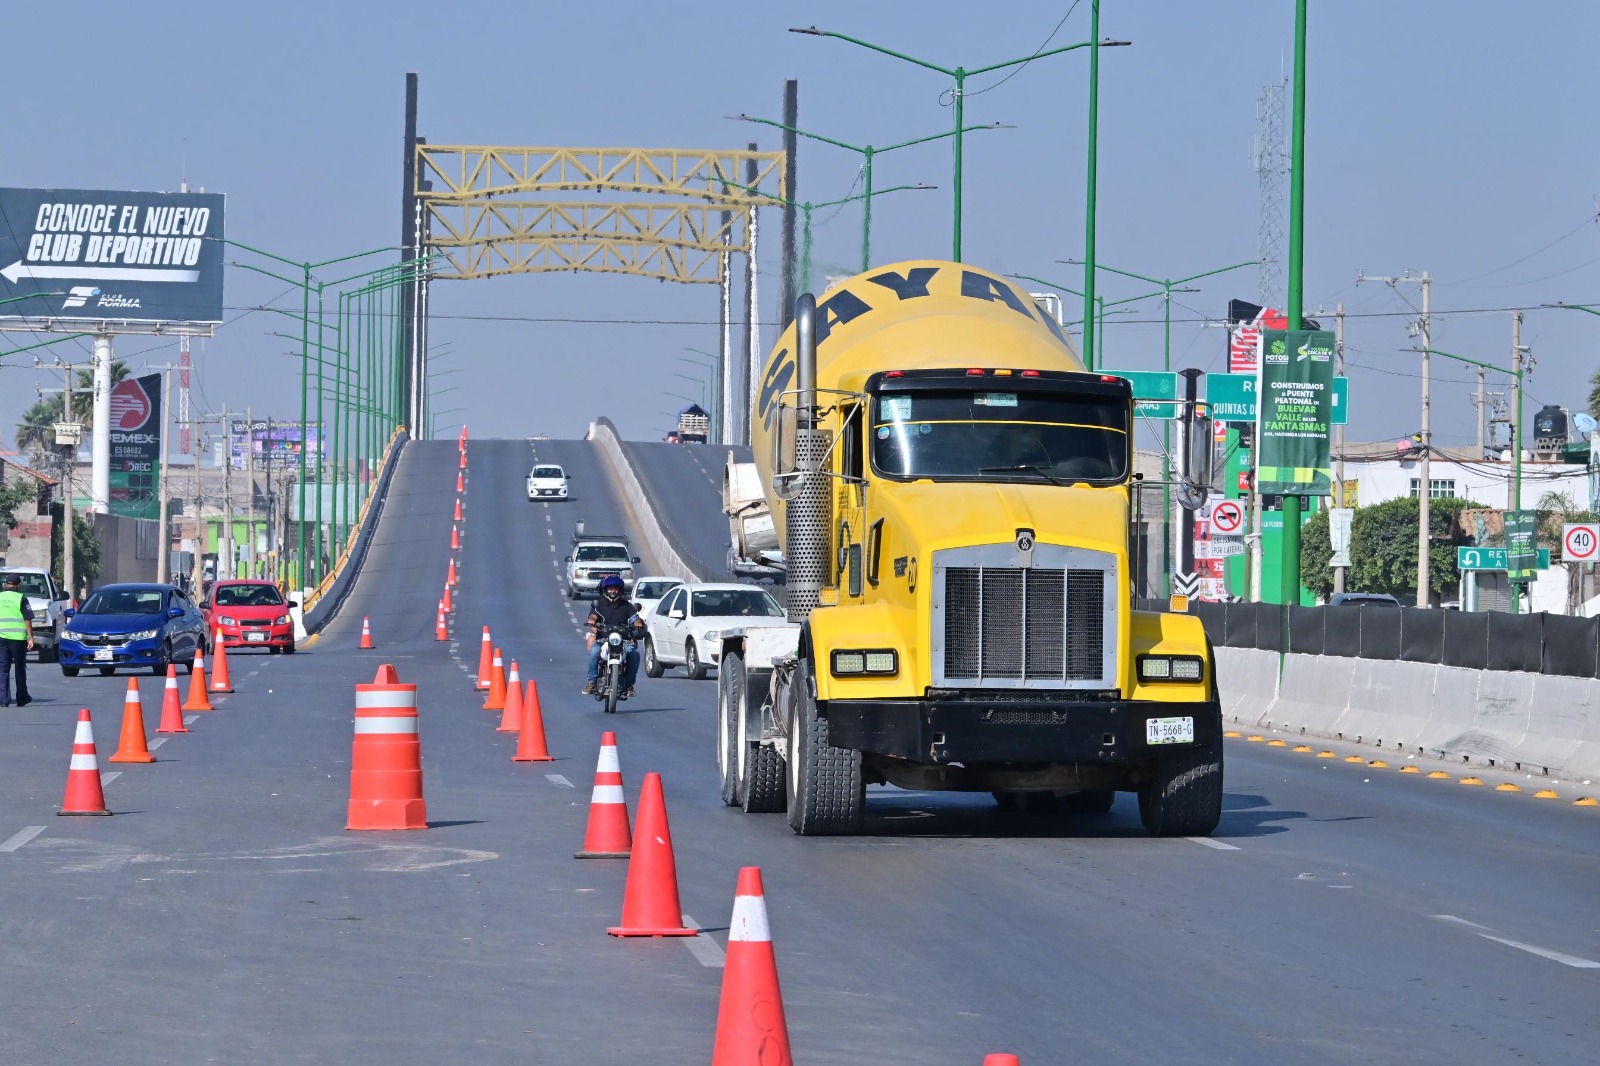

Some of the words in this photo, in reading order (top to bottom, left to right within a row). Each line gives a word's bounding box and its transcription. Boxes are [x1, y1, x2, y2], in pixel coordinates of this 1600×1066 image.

[35, 203, 117, 233] CONOCE
[118, 205, 139, 234] EL
[143, 206, 210, 236] NUEVO
[27, 233, 83, 262] CLUB
[84, 235, 202, 266] DEPORTIVO
[1271, 382, 1324, 390] CONSTRUIMOS
[1213, 402, 1248, 415] QUINTAS
[1278, 405, 1316, 413] BULEVAR
[1276, 412, 1302, 421] VALLE
[1264, 422, 1326, 431] FANTASMAS
[1574, 533, 1589, 547] 40
[1149, 724, 1191, 736] TN-5668-G
